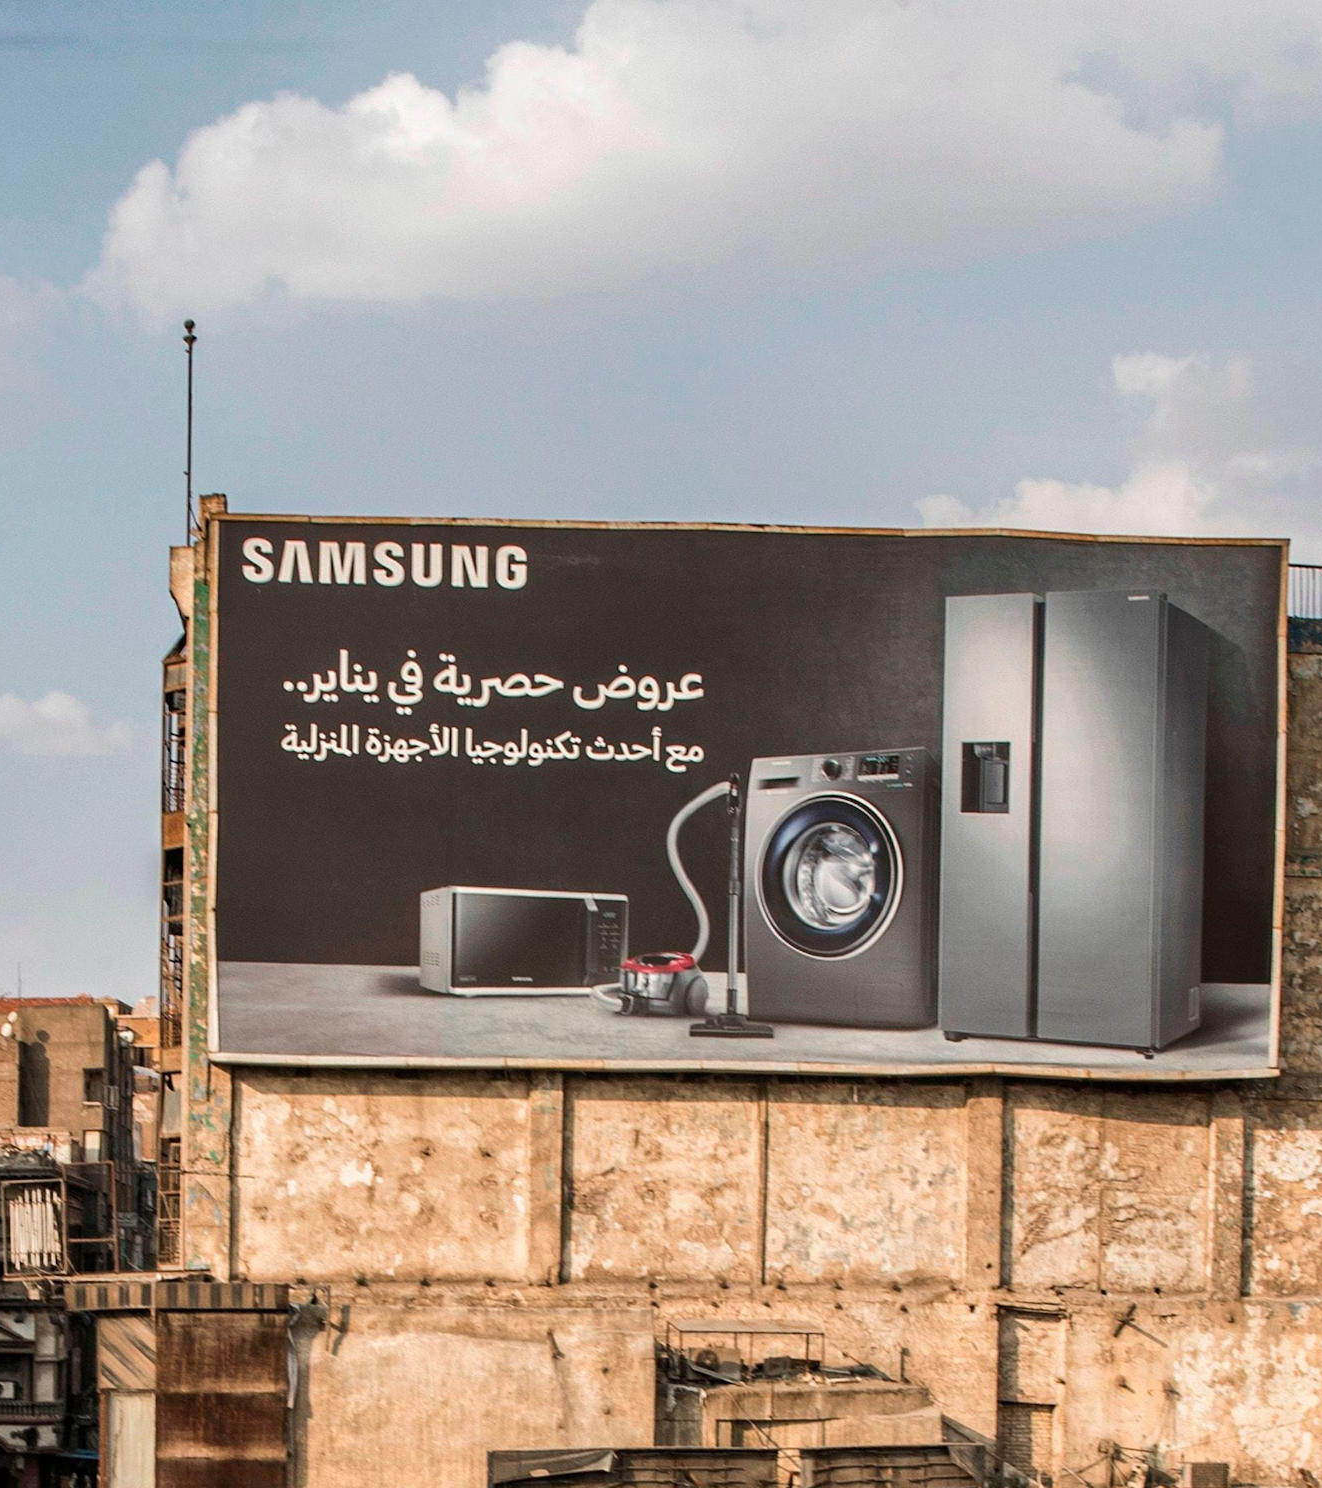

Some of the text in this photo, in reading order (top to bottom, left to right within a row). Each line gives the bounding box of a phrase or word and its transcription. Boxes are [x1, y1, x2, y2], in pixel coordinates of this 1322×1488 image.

[241, 537, 528, 590] SAMSUNG
[387, 649, 424, 716] في
[432, 652, 565, 708] حصرية
[573, 664, 705, 712] عروض
[280, 723, 705, 773] مع أحدث تكنولوجيا الأجهزة المنزلية
